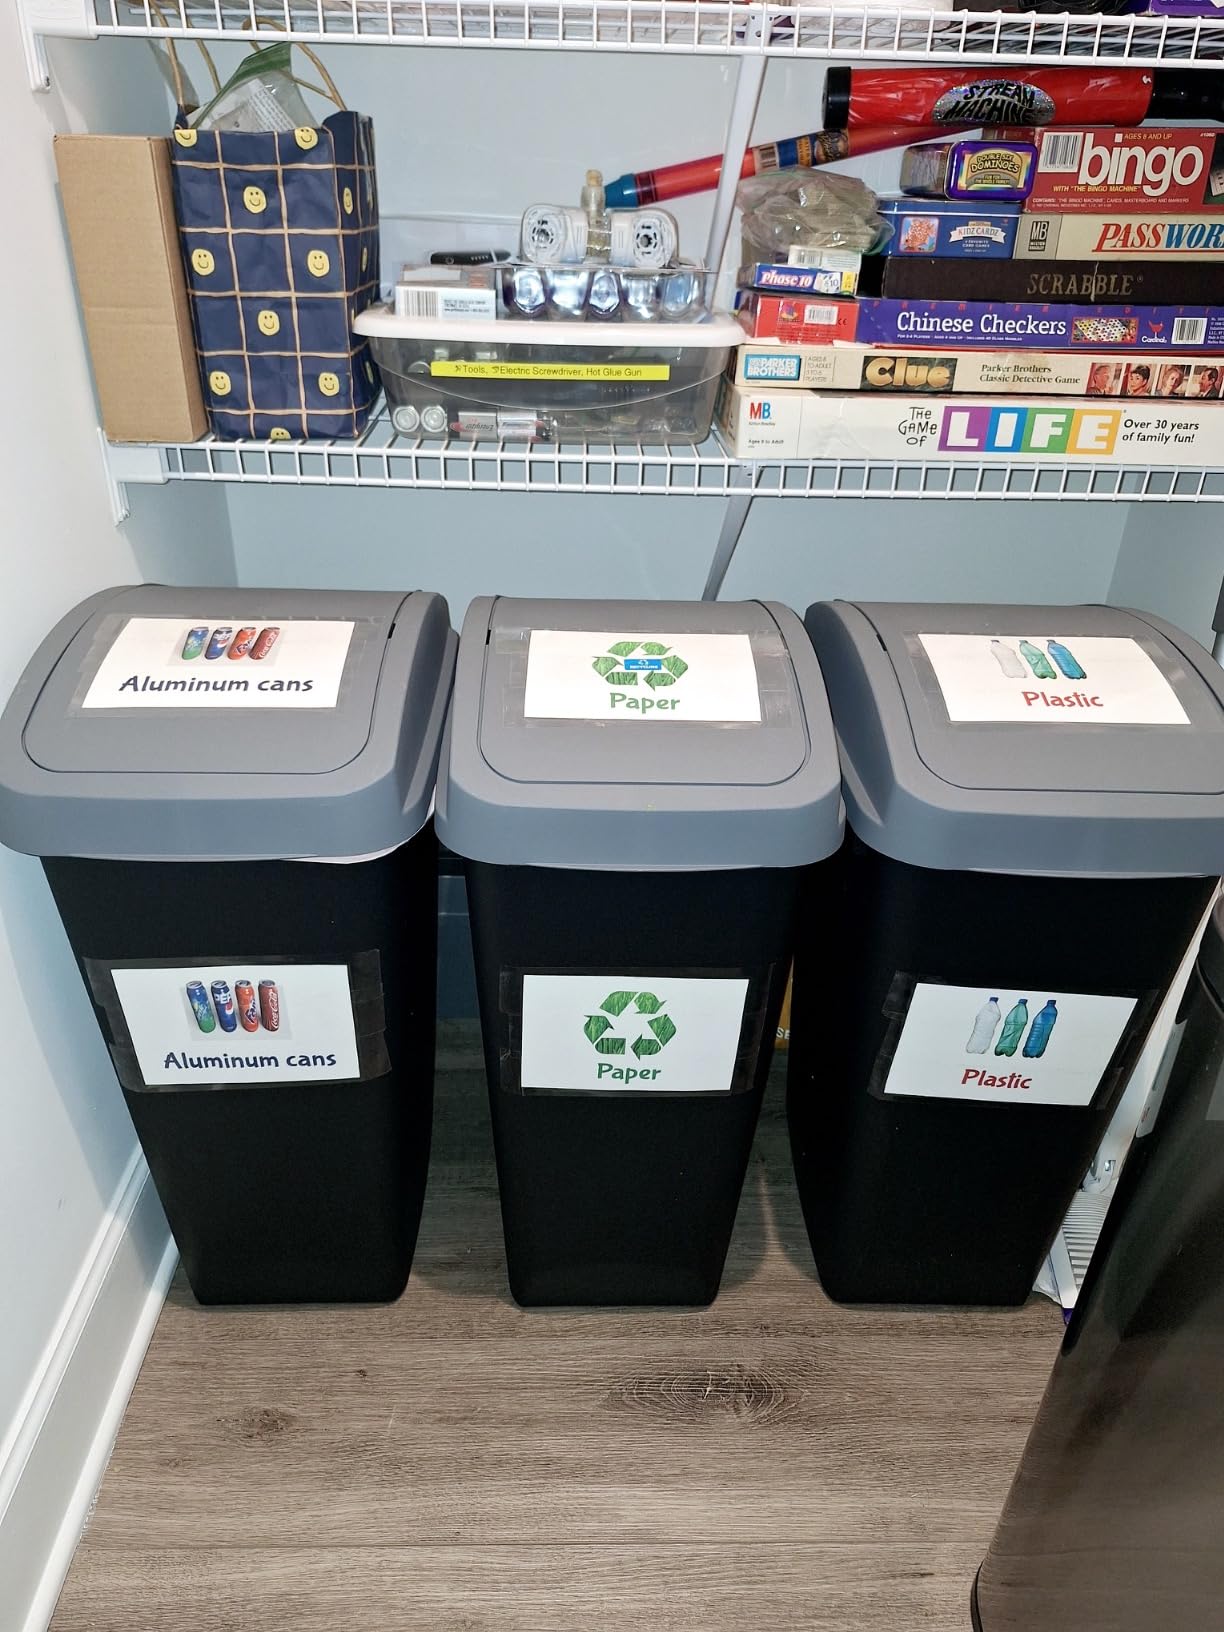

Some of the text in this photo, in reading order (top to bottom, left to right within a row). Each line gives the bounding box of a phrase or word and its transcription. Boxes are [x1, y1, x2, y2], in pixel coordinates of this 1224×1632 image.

[963, 82, 1035, 108] STREAM
[942, 98, 1034, 122] MACHINE
[971, 159, 1019, 173] DOMINOES
[977, 153, 1014, 162] DOUBLE SIX
[1078, 133, 1204, 197] bingo
[976, 227, 1000, 236] CARDZ
[1031, 222, 1048, 240] MB
[761, 270, 813, 288] Phase 10
[897, 312, 1066, 335] Chinese Checkers
[1142, 335, 1165, 344] Cardinal
[463, 366, 488, 375] Tools,
[532, 366, 584, 376] Screwdriver,
[586, 367, 602, 376] Hot
[602, 368, 622, 376] Glue
[624, 368, 642, 377] Gun
[748, 366, 796, 376] BROTHERS
[760, 358, 797, 368] PARKER
[980, 364, 1052, 373] Parker Brothers
[865, 357, 950, 388] Clue
[980, 374, 1080, 384] Classic Detective Game
[750, 402, 771, 420] MB
[946, 411, 1114, 450] LIFE
[1124, 419, 1200, 432] Over 30 years
[1122, 432, 1196, 445] of family fun!
[118, 675, 314, 692] Aluminum cans
[609, 692, 681, 714] Paper
[1021, 690, 1104, 708] Plastic
[164, 1051, 337, 1070] Aluminum cans
[597, 1062, 662, 1085] Paper
[961, 1068, 1033, 1090] Plastic
